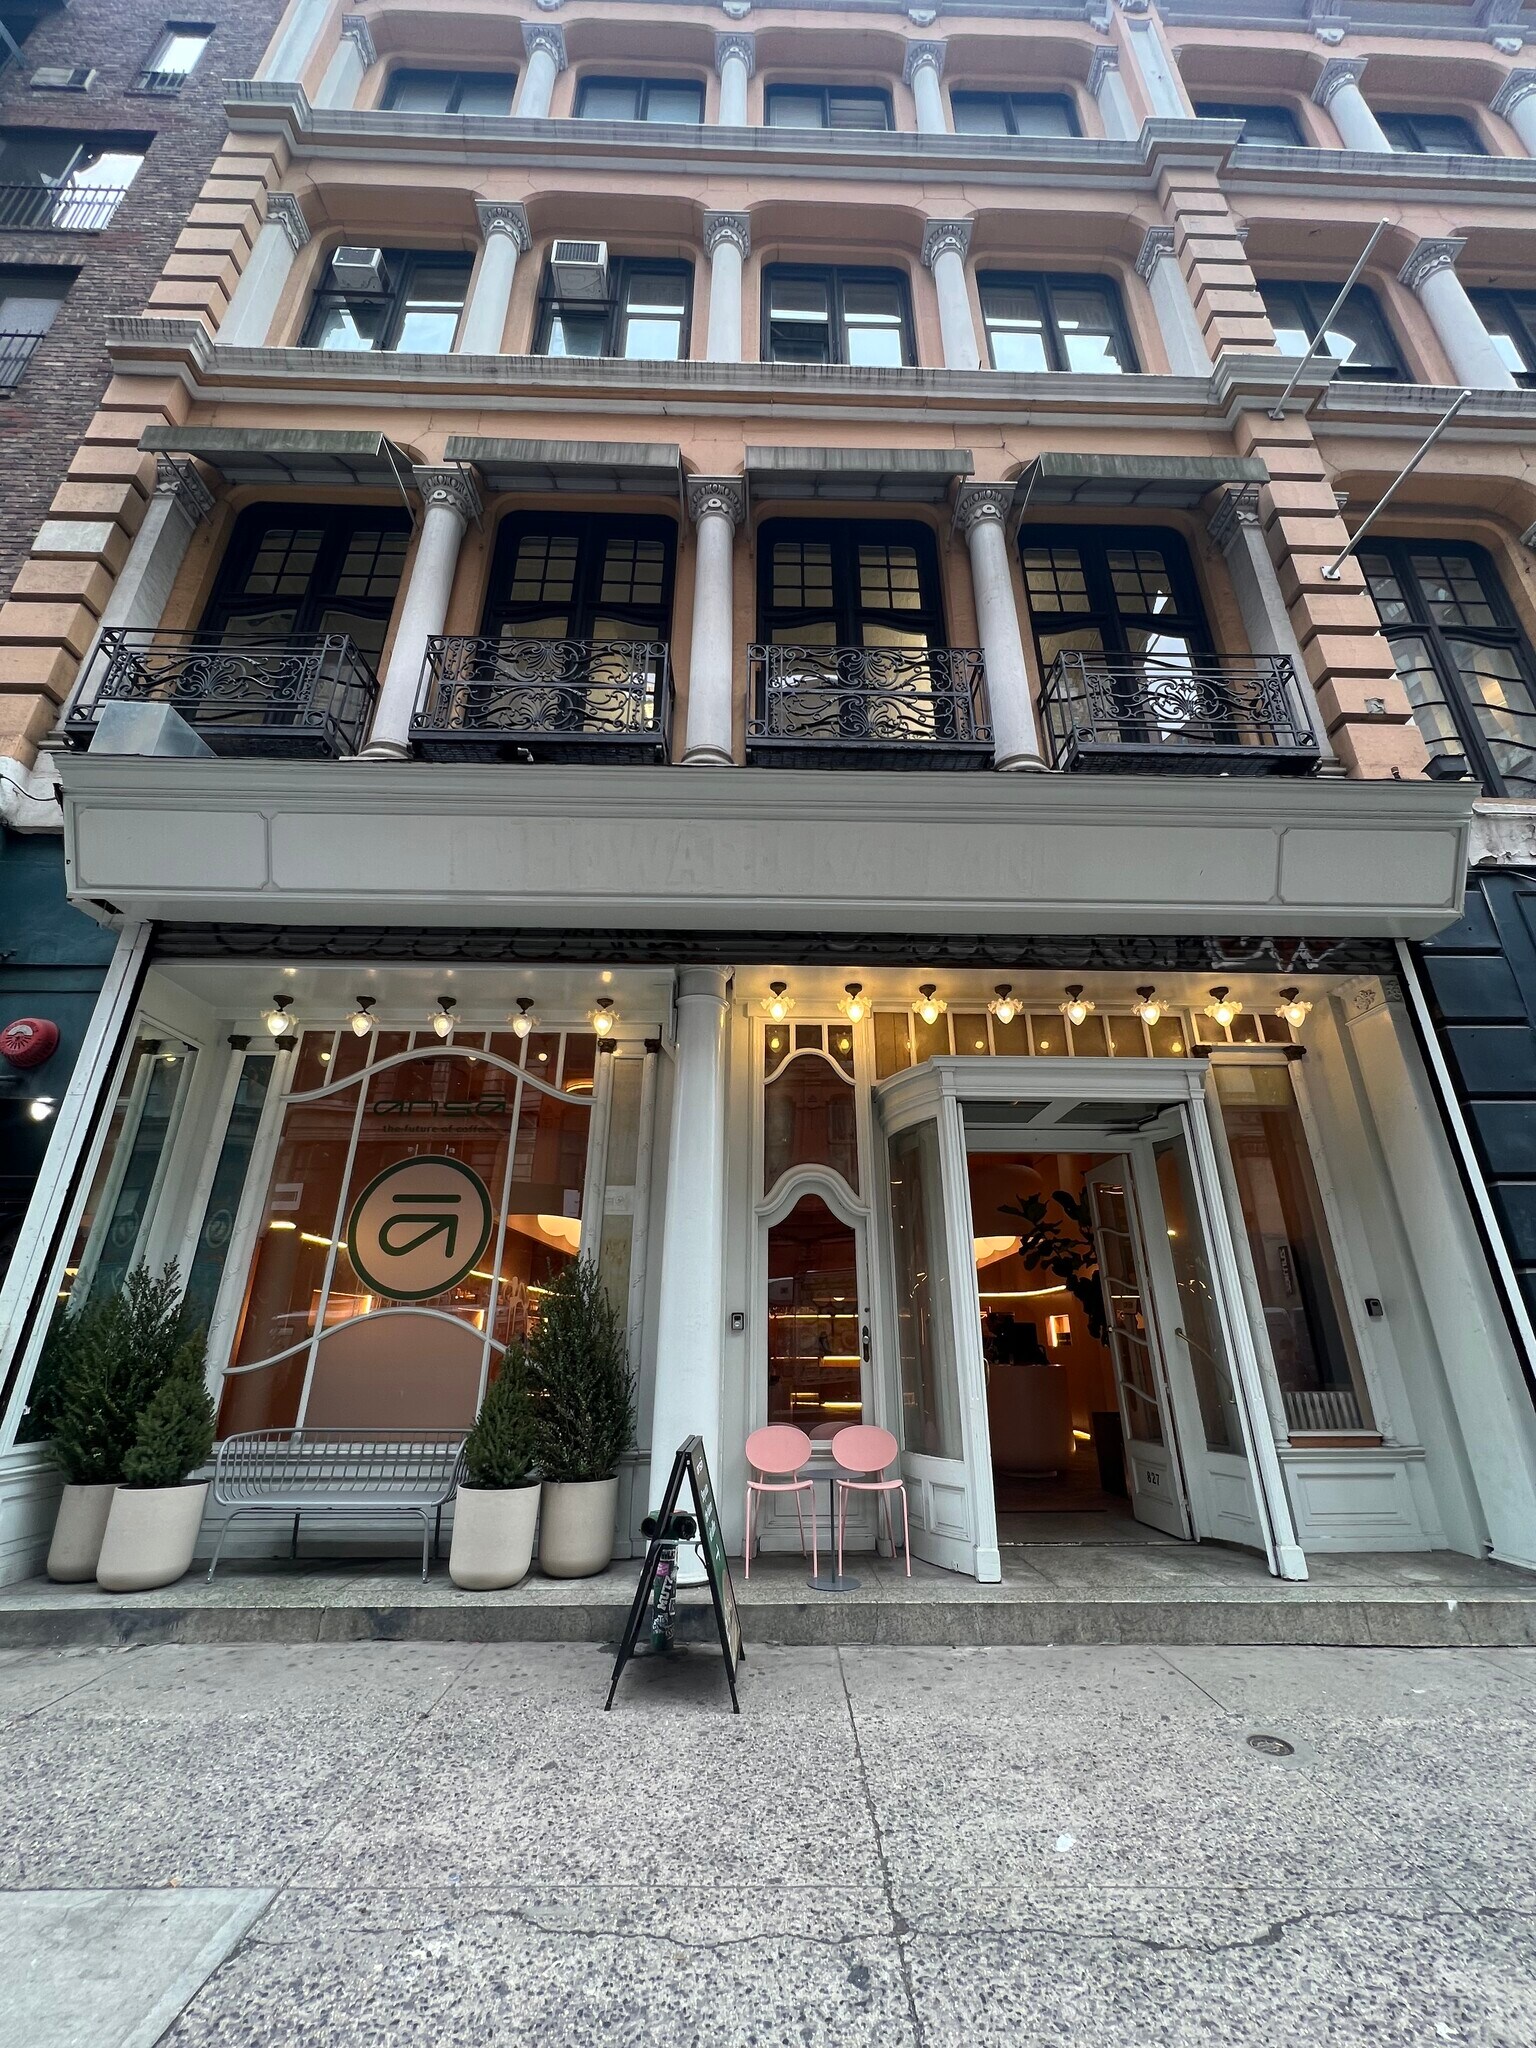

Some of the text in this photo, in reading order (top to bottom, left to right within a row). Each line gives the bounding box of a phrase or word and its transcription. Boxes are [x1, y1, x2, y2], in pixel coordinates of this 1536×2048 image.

[383, 1124, 492, 1133] the future of coffee
[1146, 1471, 1160, 1486] 827
